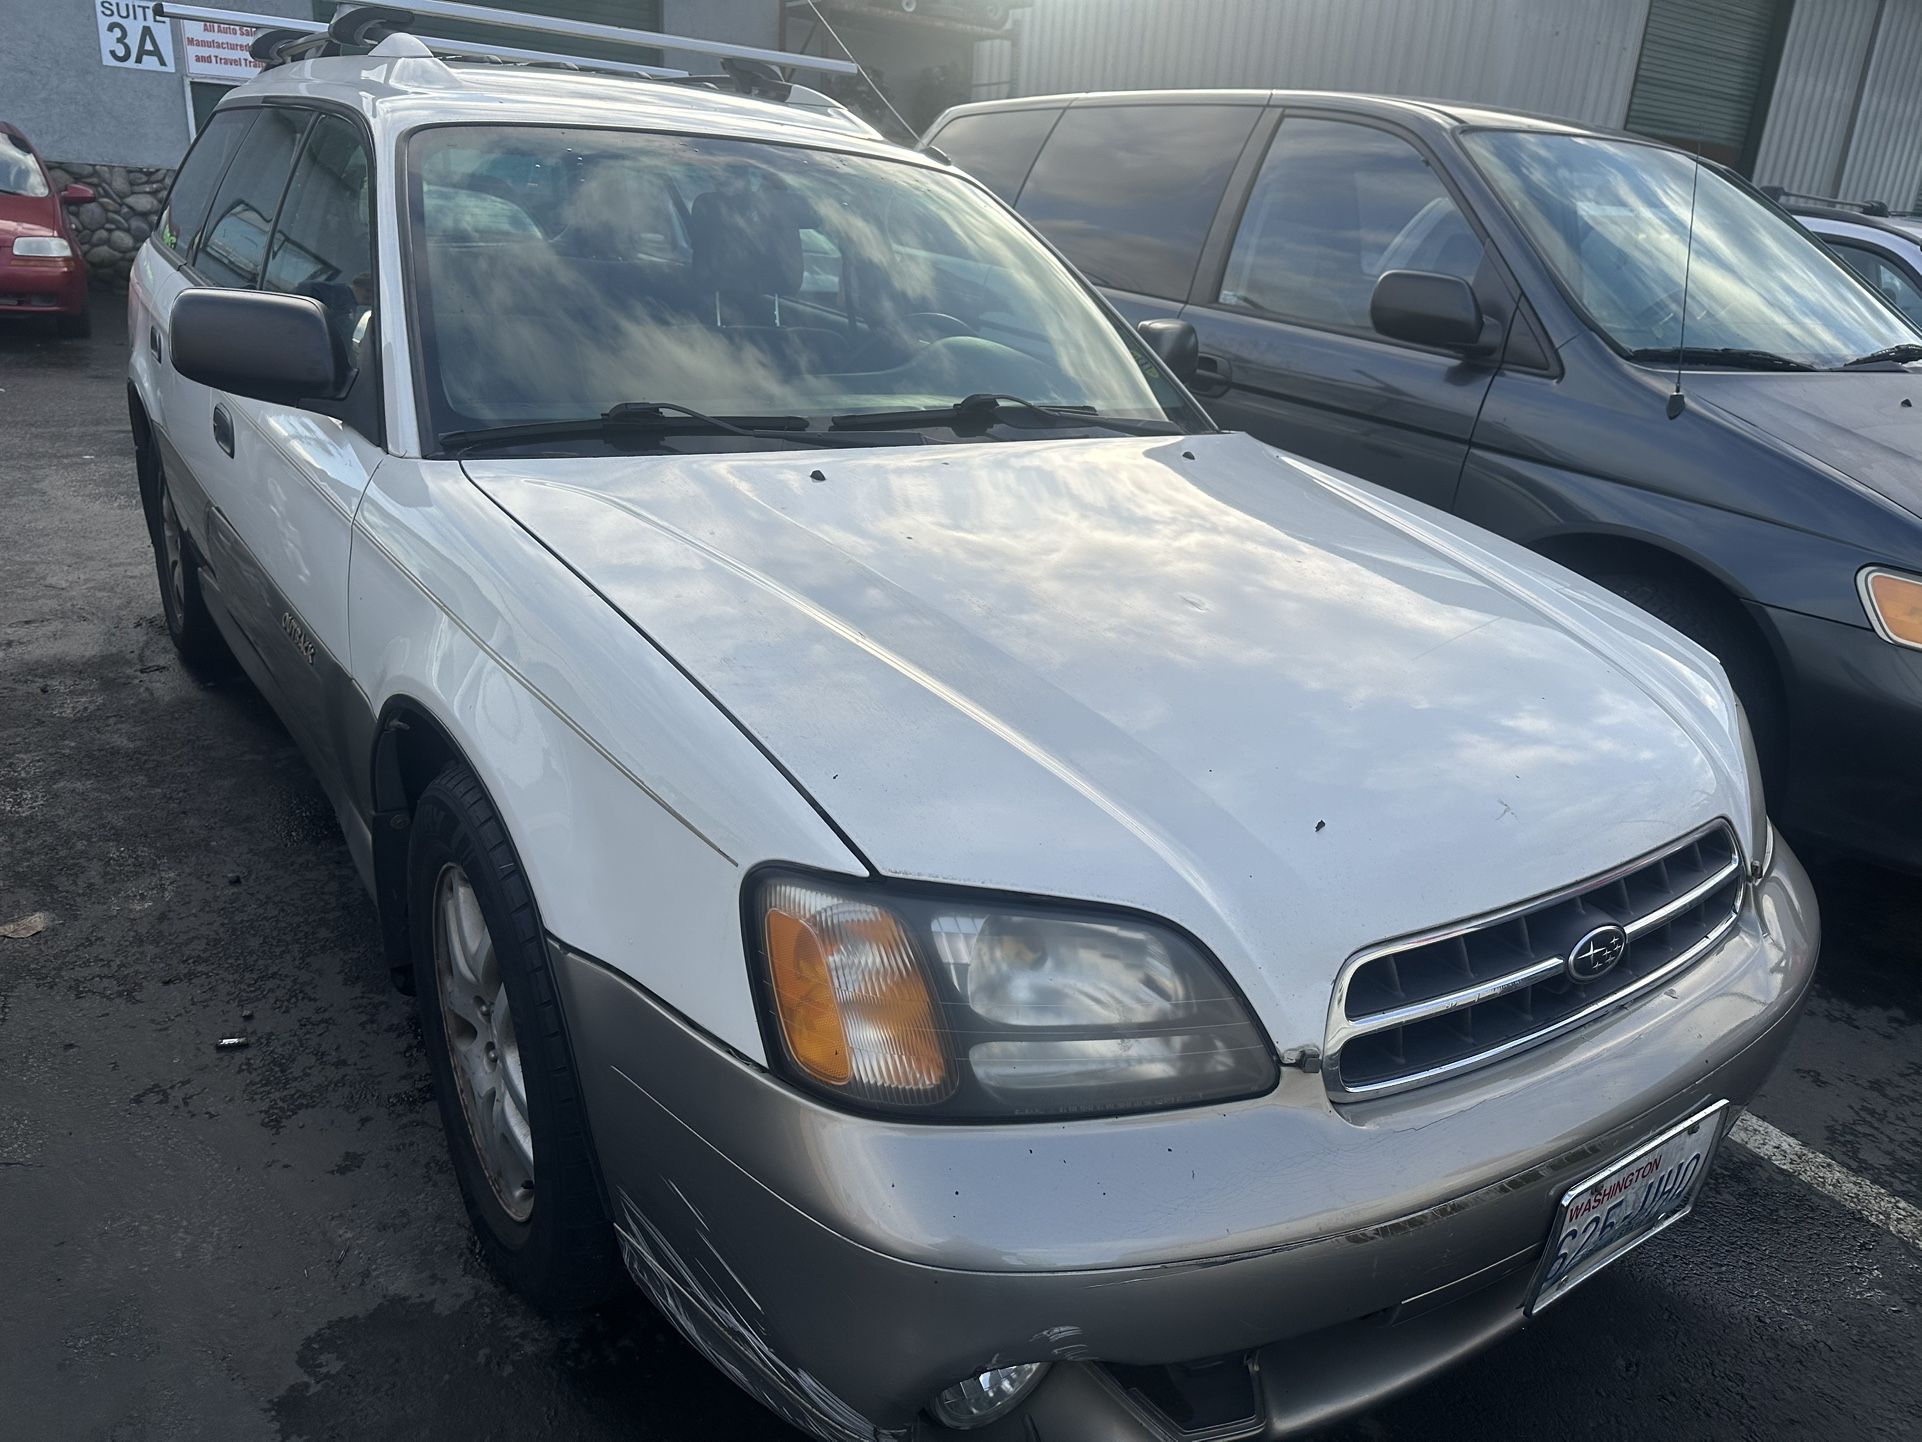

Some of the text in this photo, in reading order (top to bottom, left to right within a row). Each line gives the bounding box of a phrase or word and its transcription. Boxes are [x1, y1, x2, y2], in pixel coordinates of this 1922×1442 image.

[107, 21, 168, 67] 3A
[186, 36, 250, 52] Manufactured
[203, 22, 215, 33] All
[217, 24, 238, 36] Auto
[194, 54, 212, 64] and
[214, 55, 242, 67] Travel
[282, 612, 315, 665] OUTBACK
[1568, 1154, 1663, 1223] WASHINGTON
